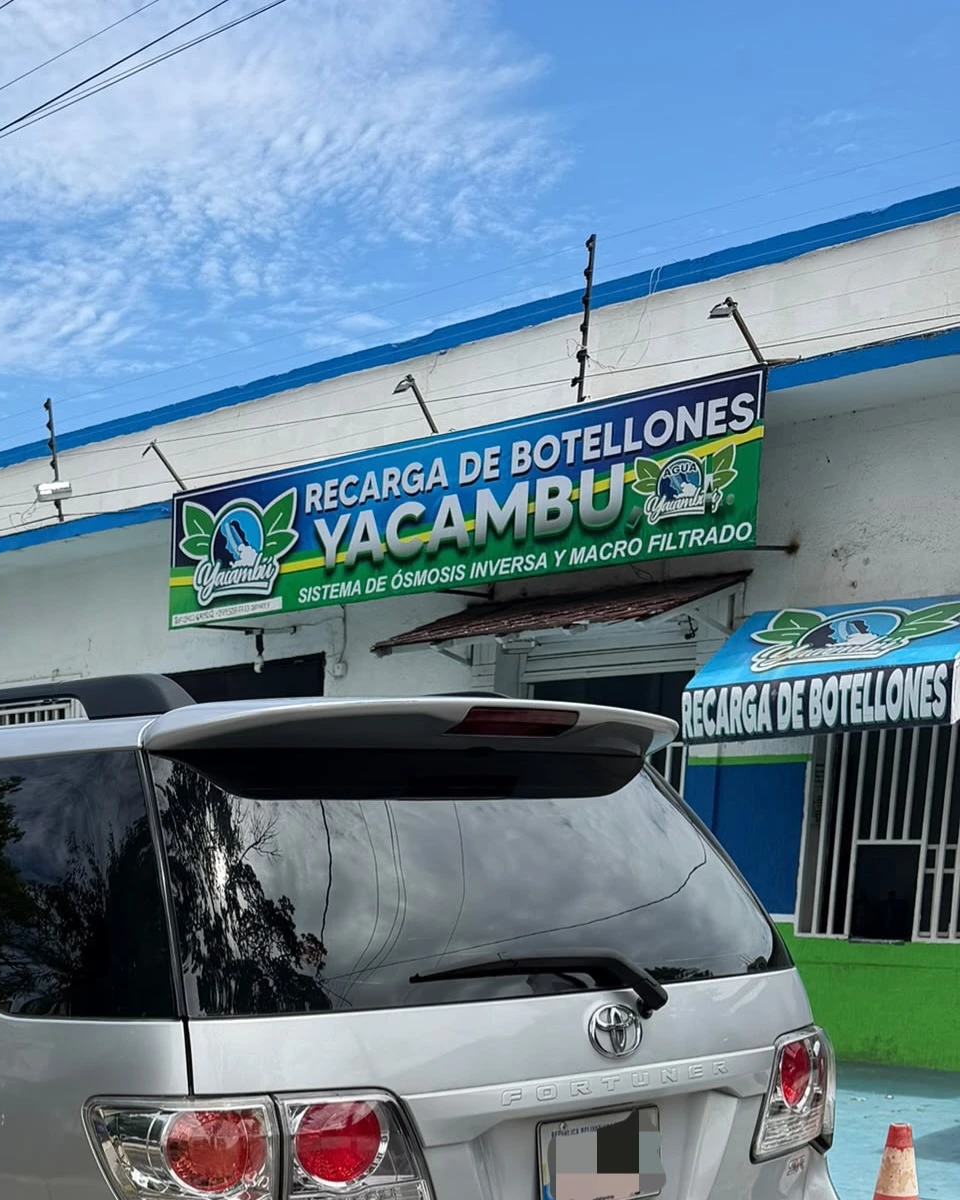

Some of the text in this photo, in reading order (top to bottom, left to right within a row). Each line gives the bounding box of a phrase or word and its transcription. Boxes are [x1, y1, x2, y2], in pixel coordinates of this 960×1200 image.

[304, 392, 756, 514] RECARGA DE BOTELLONES
[662, 463, 697, 479] AGUA
[196, 554, 276, 602] Yacambú
[297, 521, 753, 604] SISTEMA DE ÓSMOSIS INVERSA Y MACRO FILTRADO
[682, 662, 949, 740] RECARGA DE BOTELLONES
[500, 1060, 730, 1107] FORTUNER
